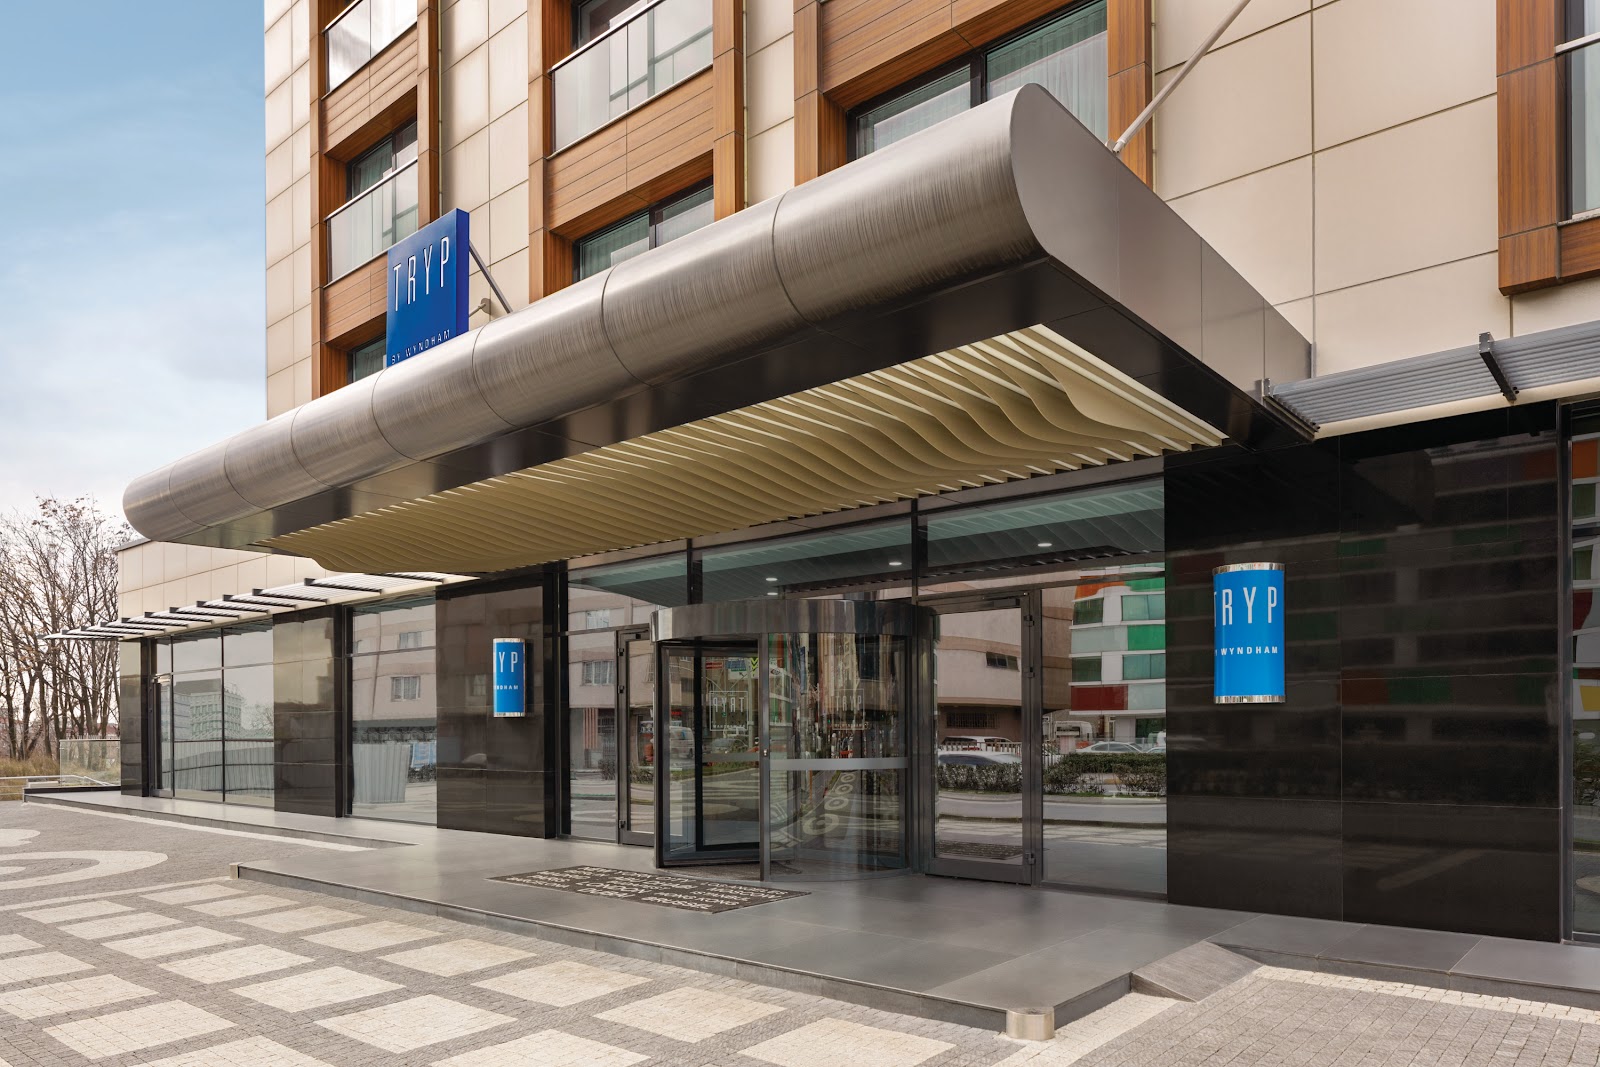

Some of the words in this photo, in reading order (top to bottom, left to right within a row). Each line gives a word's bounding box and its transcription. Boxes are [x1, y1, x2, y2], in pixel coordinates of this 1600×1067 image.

[393, 236, 449, 312] TRYP
[405, 329, 450, 357] WYNDHAM
[498, 651, 518, 673] YP
[1220, 646, 1278, 656] WYNDHAM
[576, 881, 652, 894] LONDON
